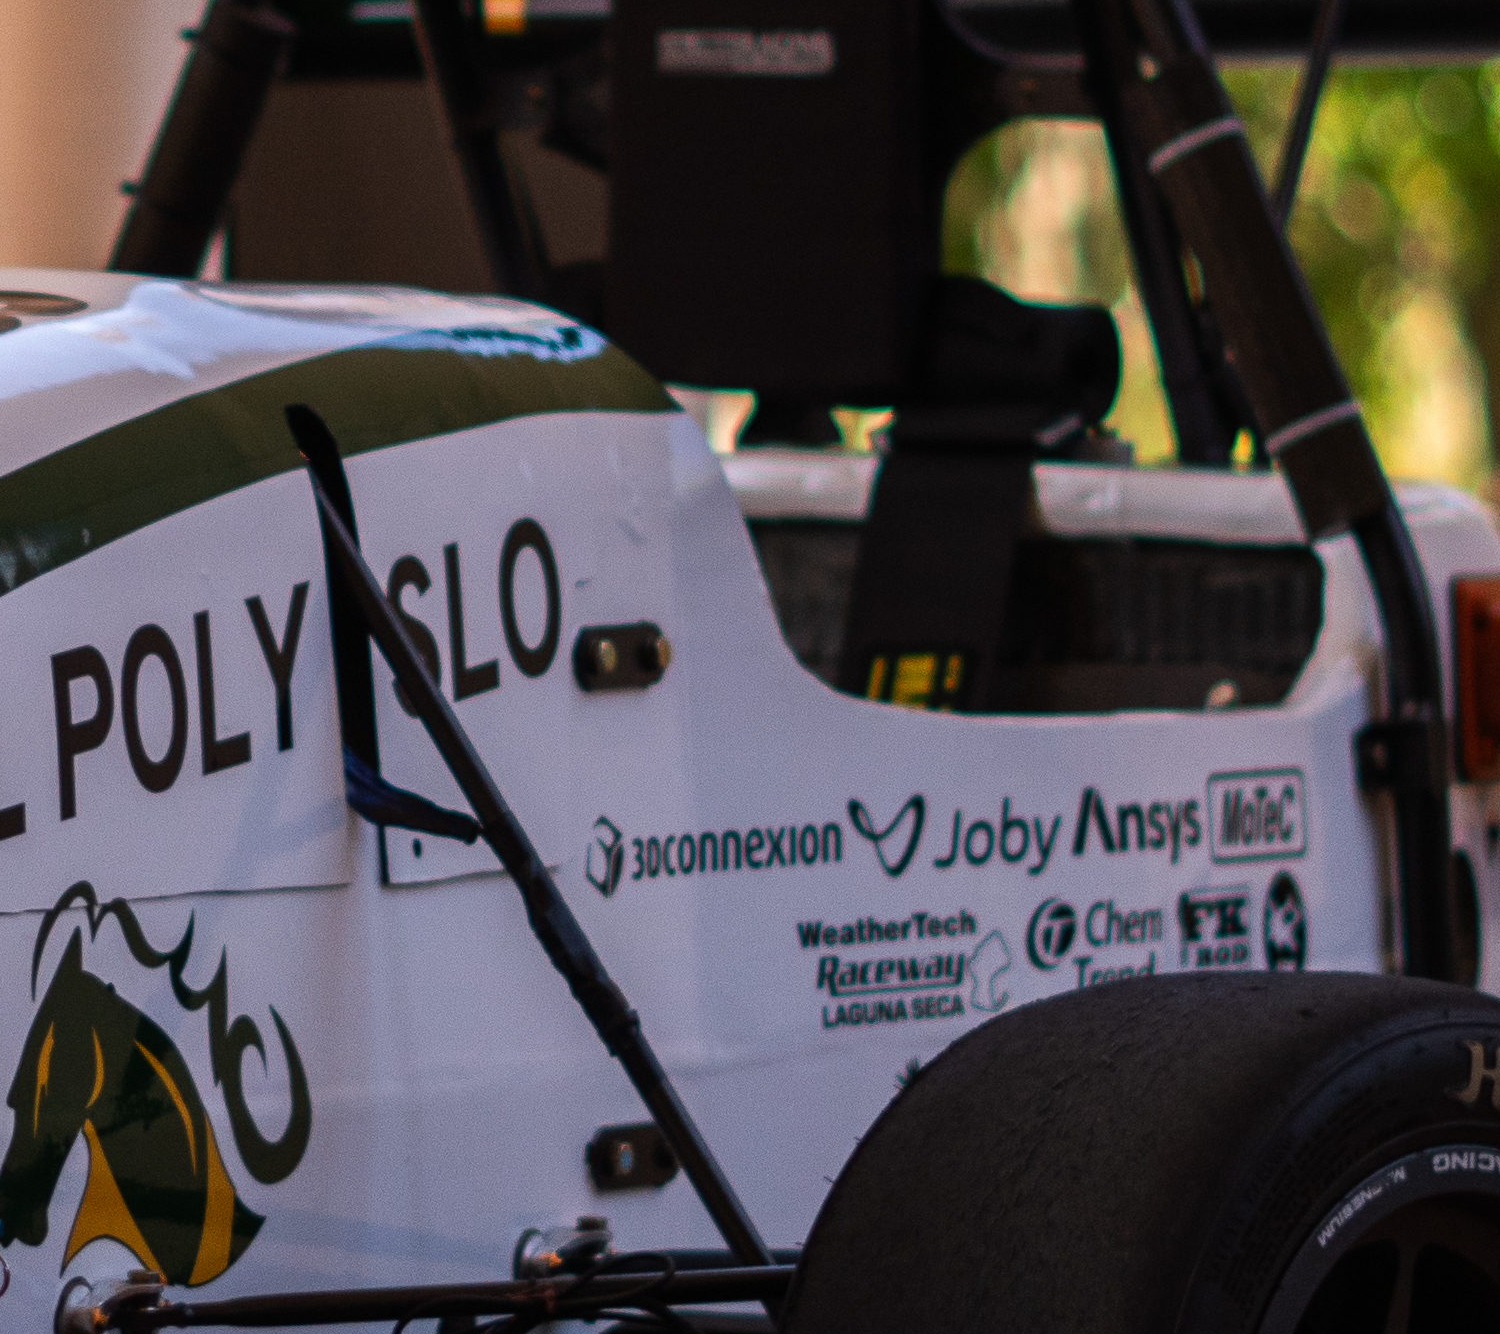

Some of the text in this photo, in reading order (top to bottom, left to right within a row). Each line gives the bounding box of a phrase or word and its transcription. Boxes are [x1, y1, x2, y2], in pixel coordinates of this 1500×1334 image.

[51, 581, 310, 822] POLY
[385, 517, 563, 719] SLO
[934, 797, 1062, 876] Joby
[1072, 787, 1202, 865] Ansys
[1220, 784, 1296, 846] MoTeC
[798, 910, 976, 948] WeatherTech
[1085, 898, 1164, 948] Chem
[817, 954, 965, 996] Raceway
[822, 994, 965, 1029] LAGUNA SECA
[1316, 1165, 1408, 1249] MNESIUM
